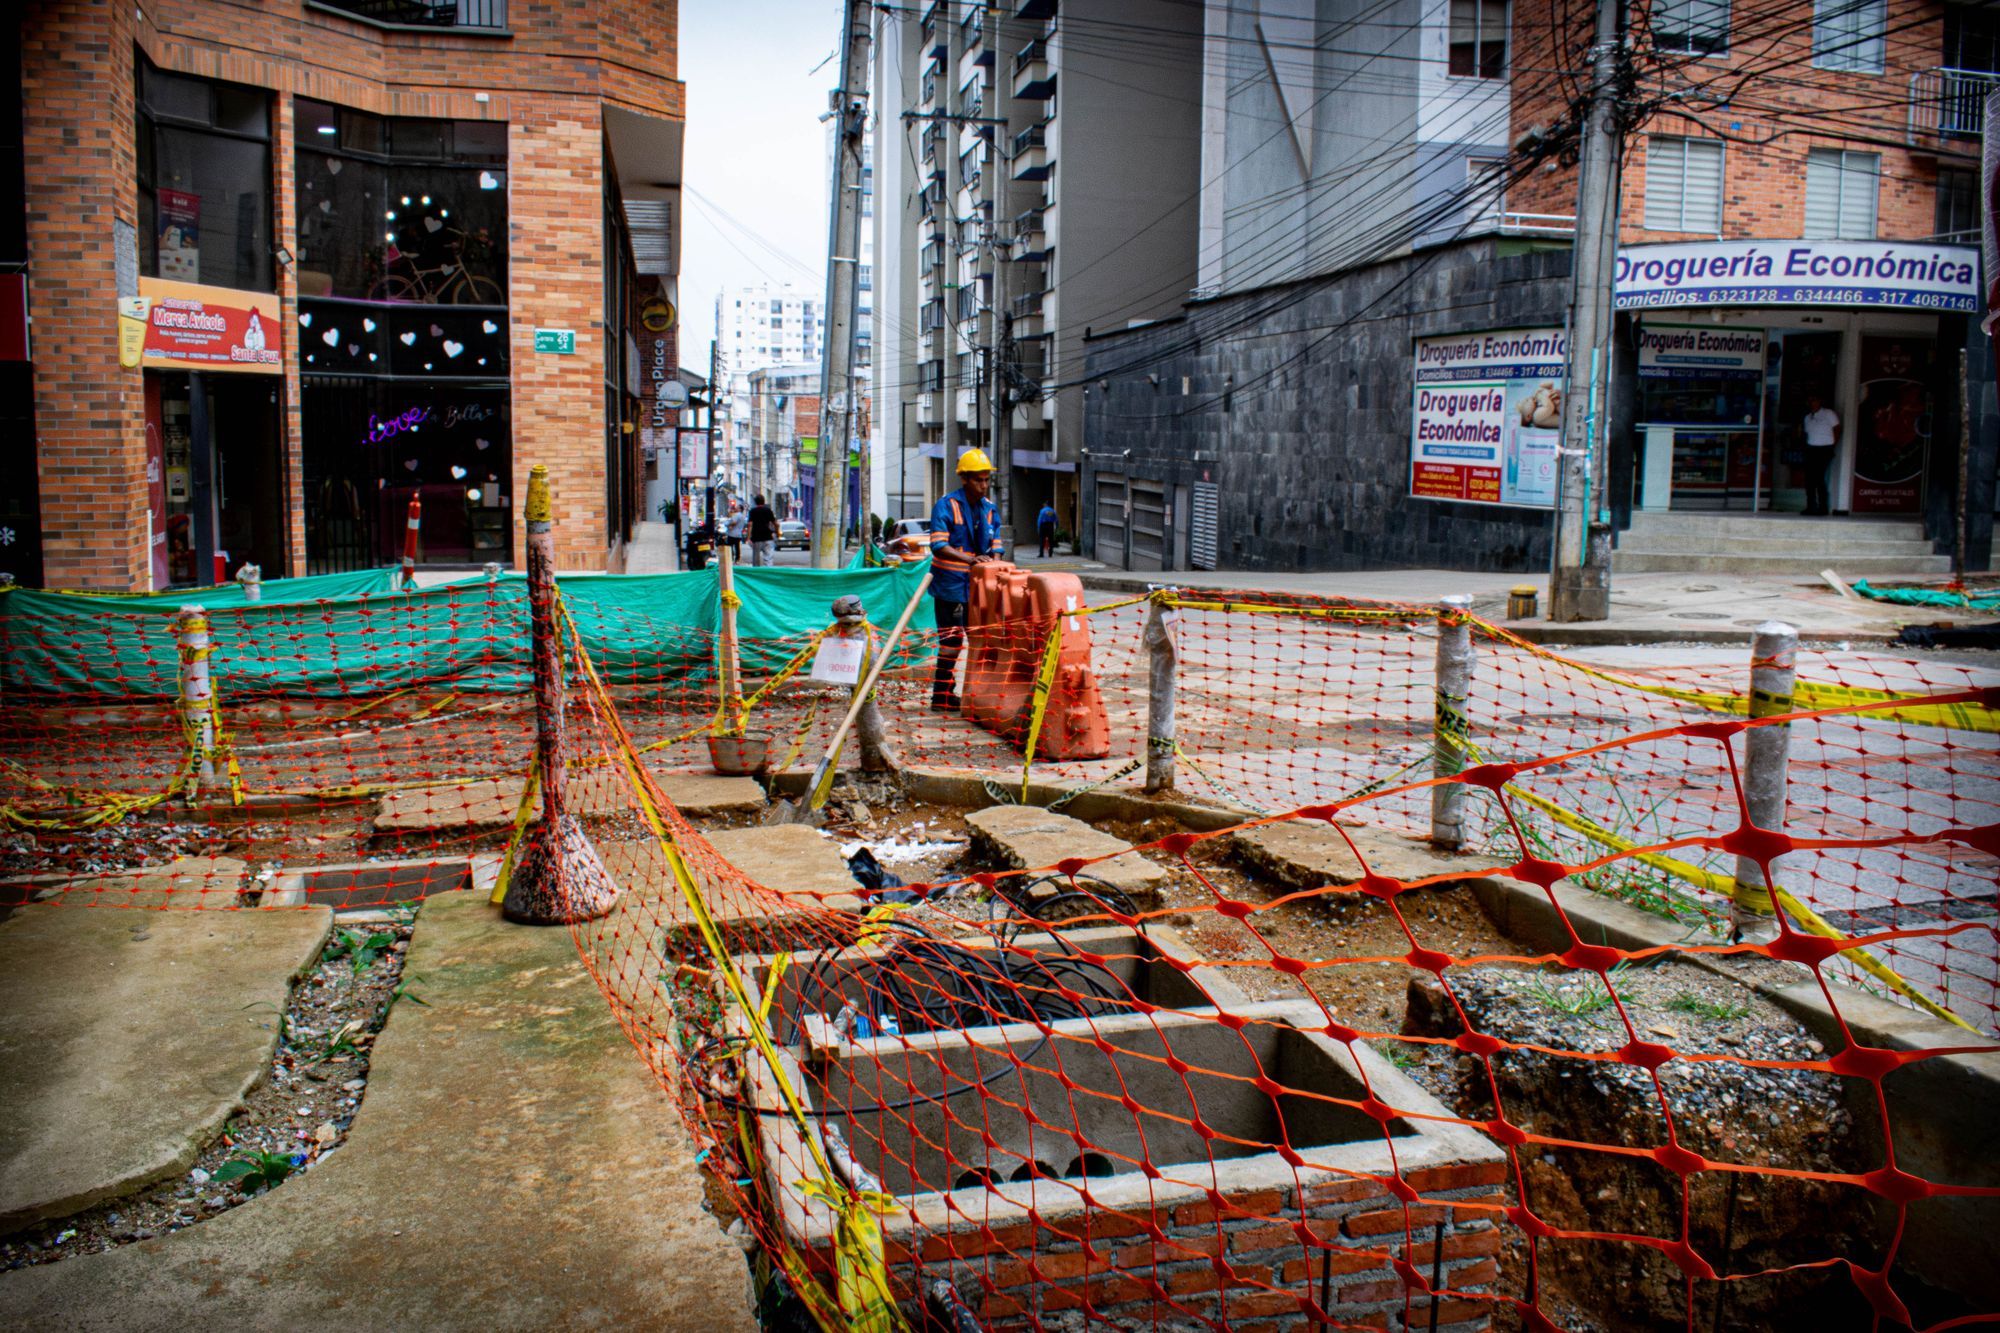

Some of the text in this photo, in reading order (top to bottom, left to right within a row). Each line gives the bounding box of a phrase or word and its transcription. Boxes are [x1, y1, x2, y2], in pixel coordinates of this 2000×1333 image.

[1784, 249, 1973, 285] Económica
[1616, 289, 1702, 308] omicilios:
[1708, 289, 1778, 302] 6323128
[1793, 289, 1863, 303] 6344466
[1878, 291, 1908, 304] 317
[1911, 294, 1975, 311] 4087146
[153, 307, 188, 329] Merca
[230, 344, 257, 362] Santa
[257, 349, 280, 364] Cruz
[1419, 333, 1566, 366] Droguería Económic
[1697, 331, 1763, 354] Económica
[1520, 366, 1535, 376] 317
[1537, 365, 1563, 377] 4087
[652, 339, 666, 427] Urbn Place
[1419, 389, 1503, 417] Droguería
[1418, 419, 1502, 443] Económica
